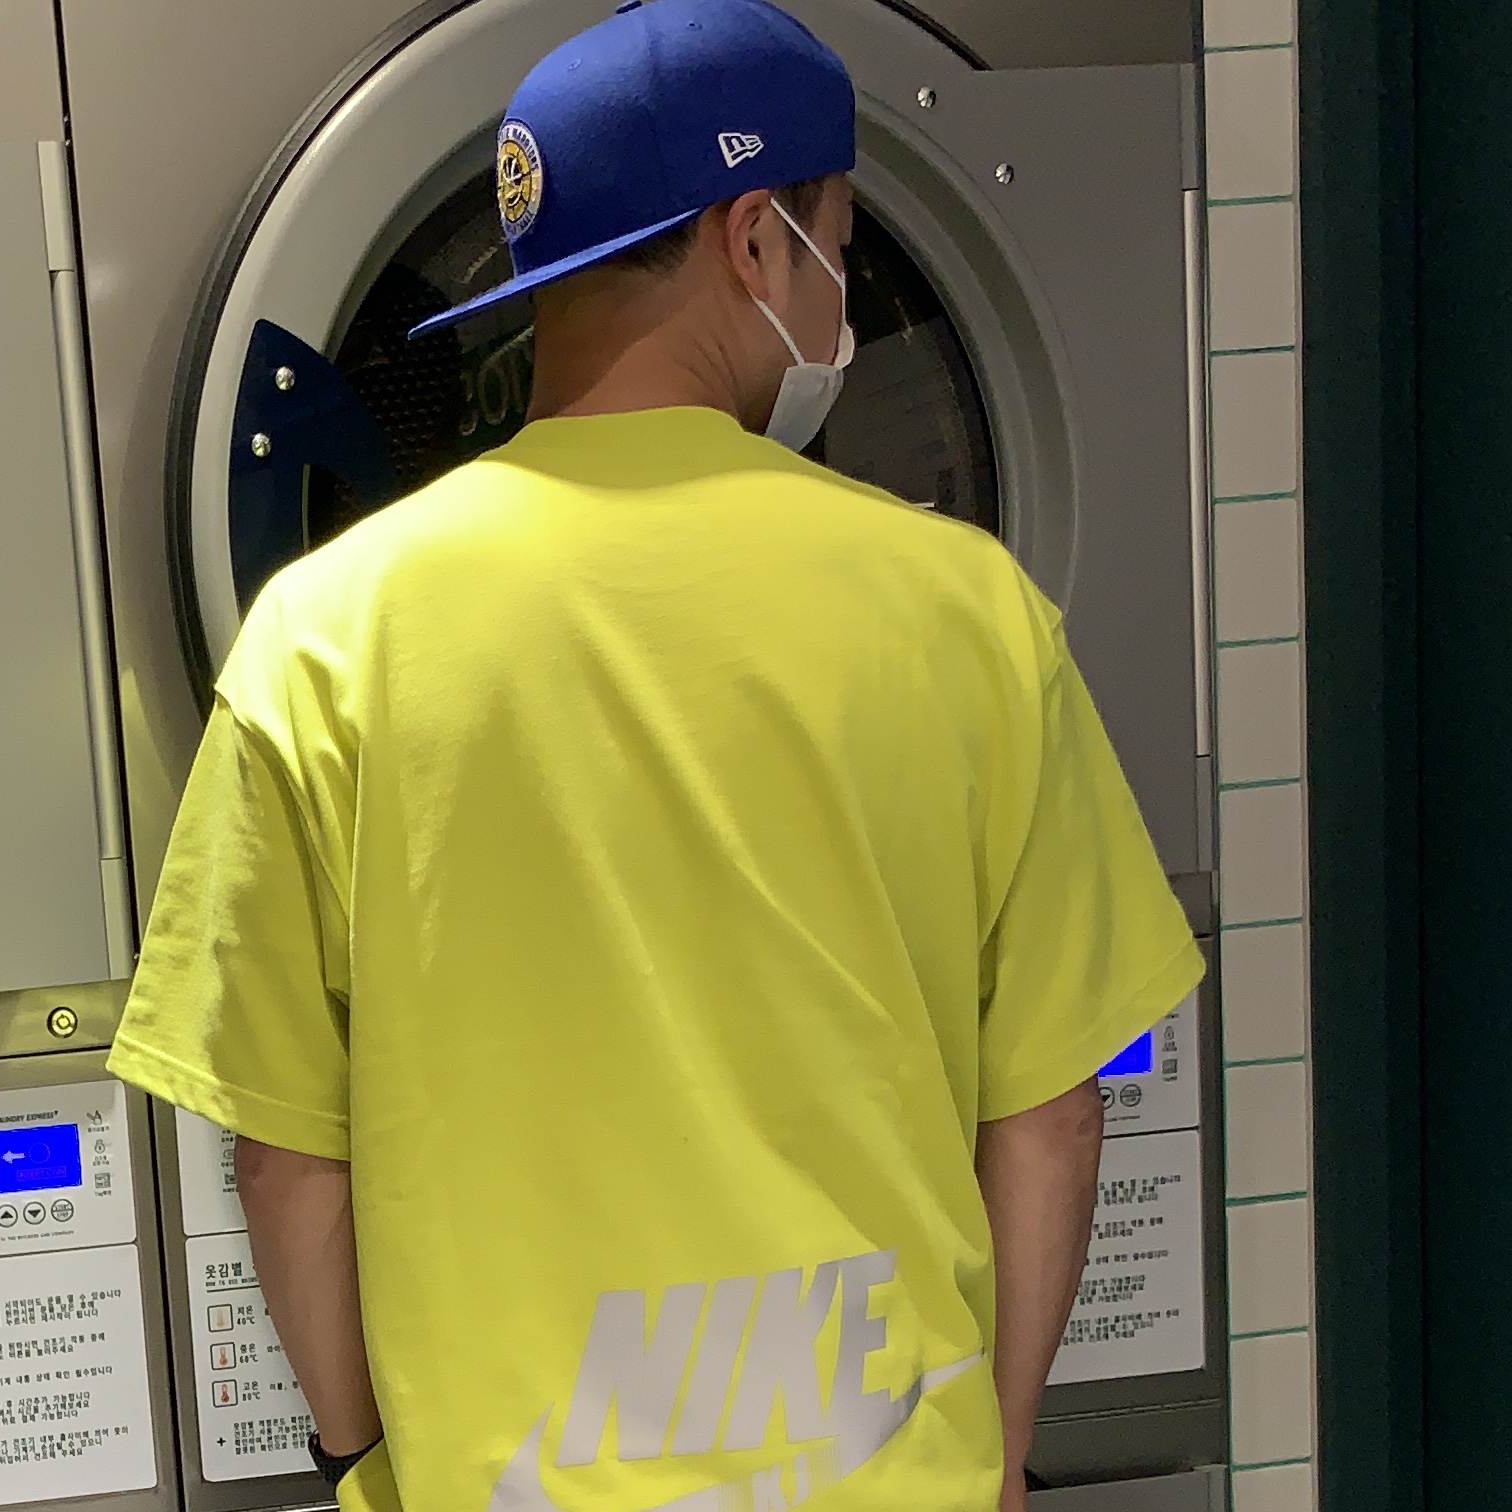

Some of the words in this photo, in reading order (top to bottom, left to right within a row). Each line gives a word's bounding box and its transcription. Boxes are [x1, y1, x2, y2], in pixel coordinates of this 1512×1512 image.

[204, 1261, 242, 1279] 옷감별
[555, 1248, 897, 1468] NIKE
[243, 1381, 258, 1391] 고온
